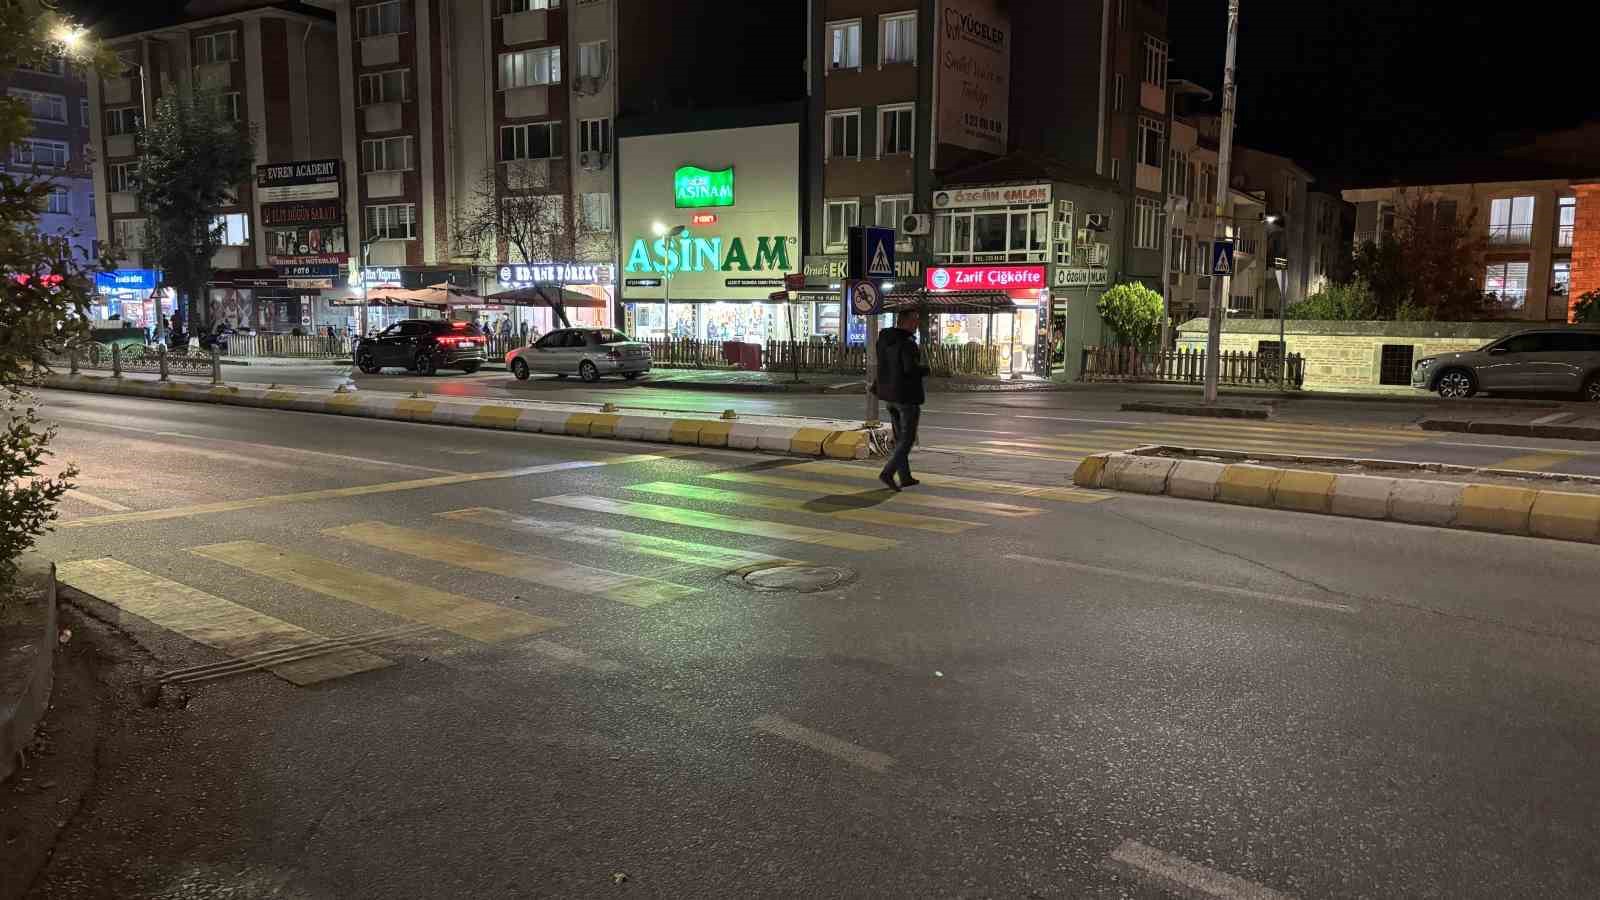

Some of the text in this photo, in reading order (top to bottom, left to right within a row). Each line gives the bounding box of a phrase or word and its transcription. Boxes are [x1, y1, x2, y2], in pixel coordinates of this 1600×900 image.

[268, 165, 294, 180] EVREN
[296, 162, 335, 177] ACADEMY
[804, 261, 849, 278] Örnek EK
[955, 270, 1041, 285] Zarif Çiğköfte
